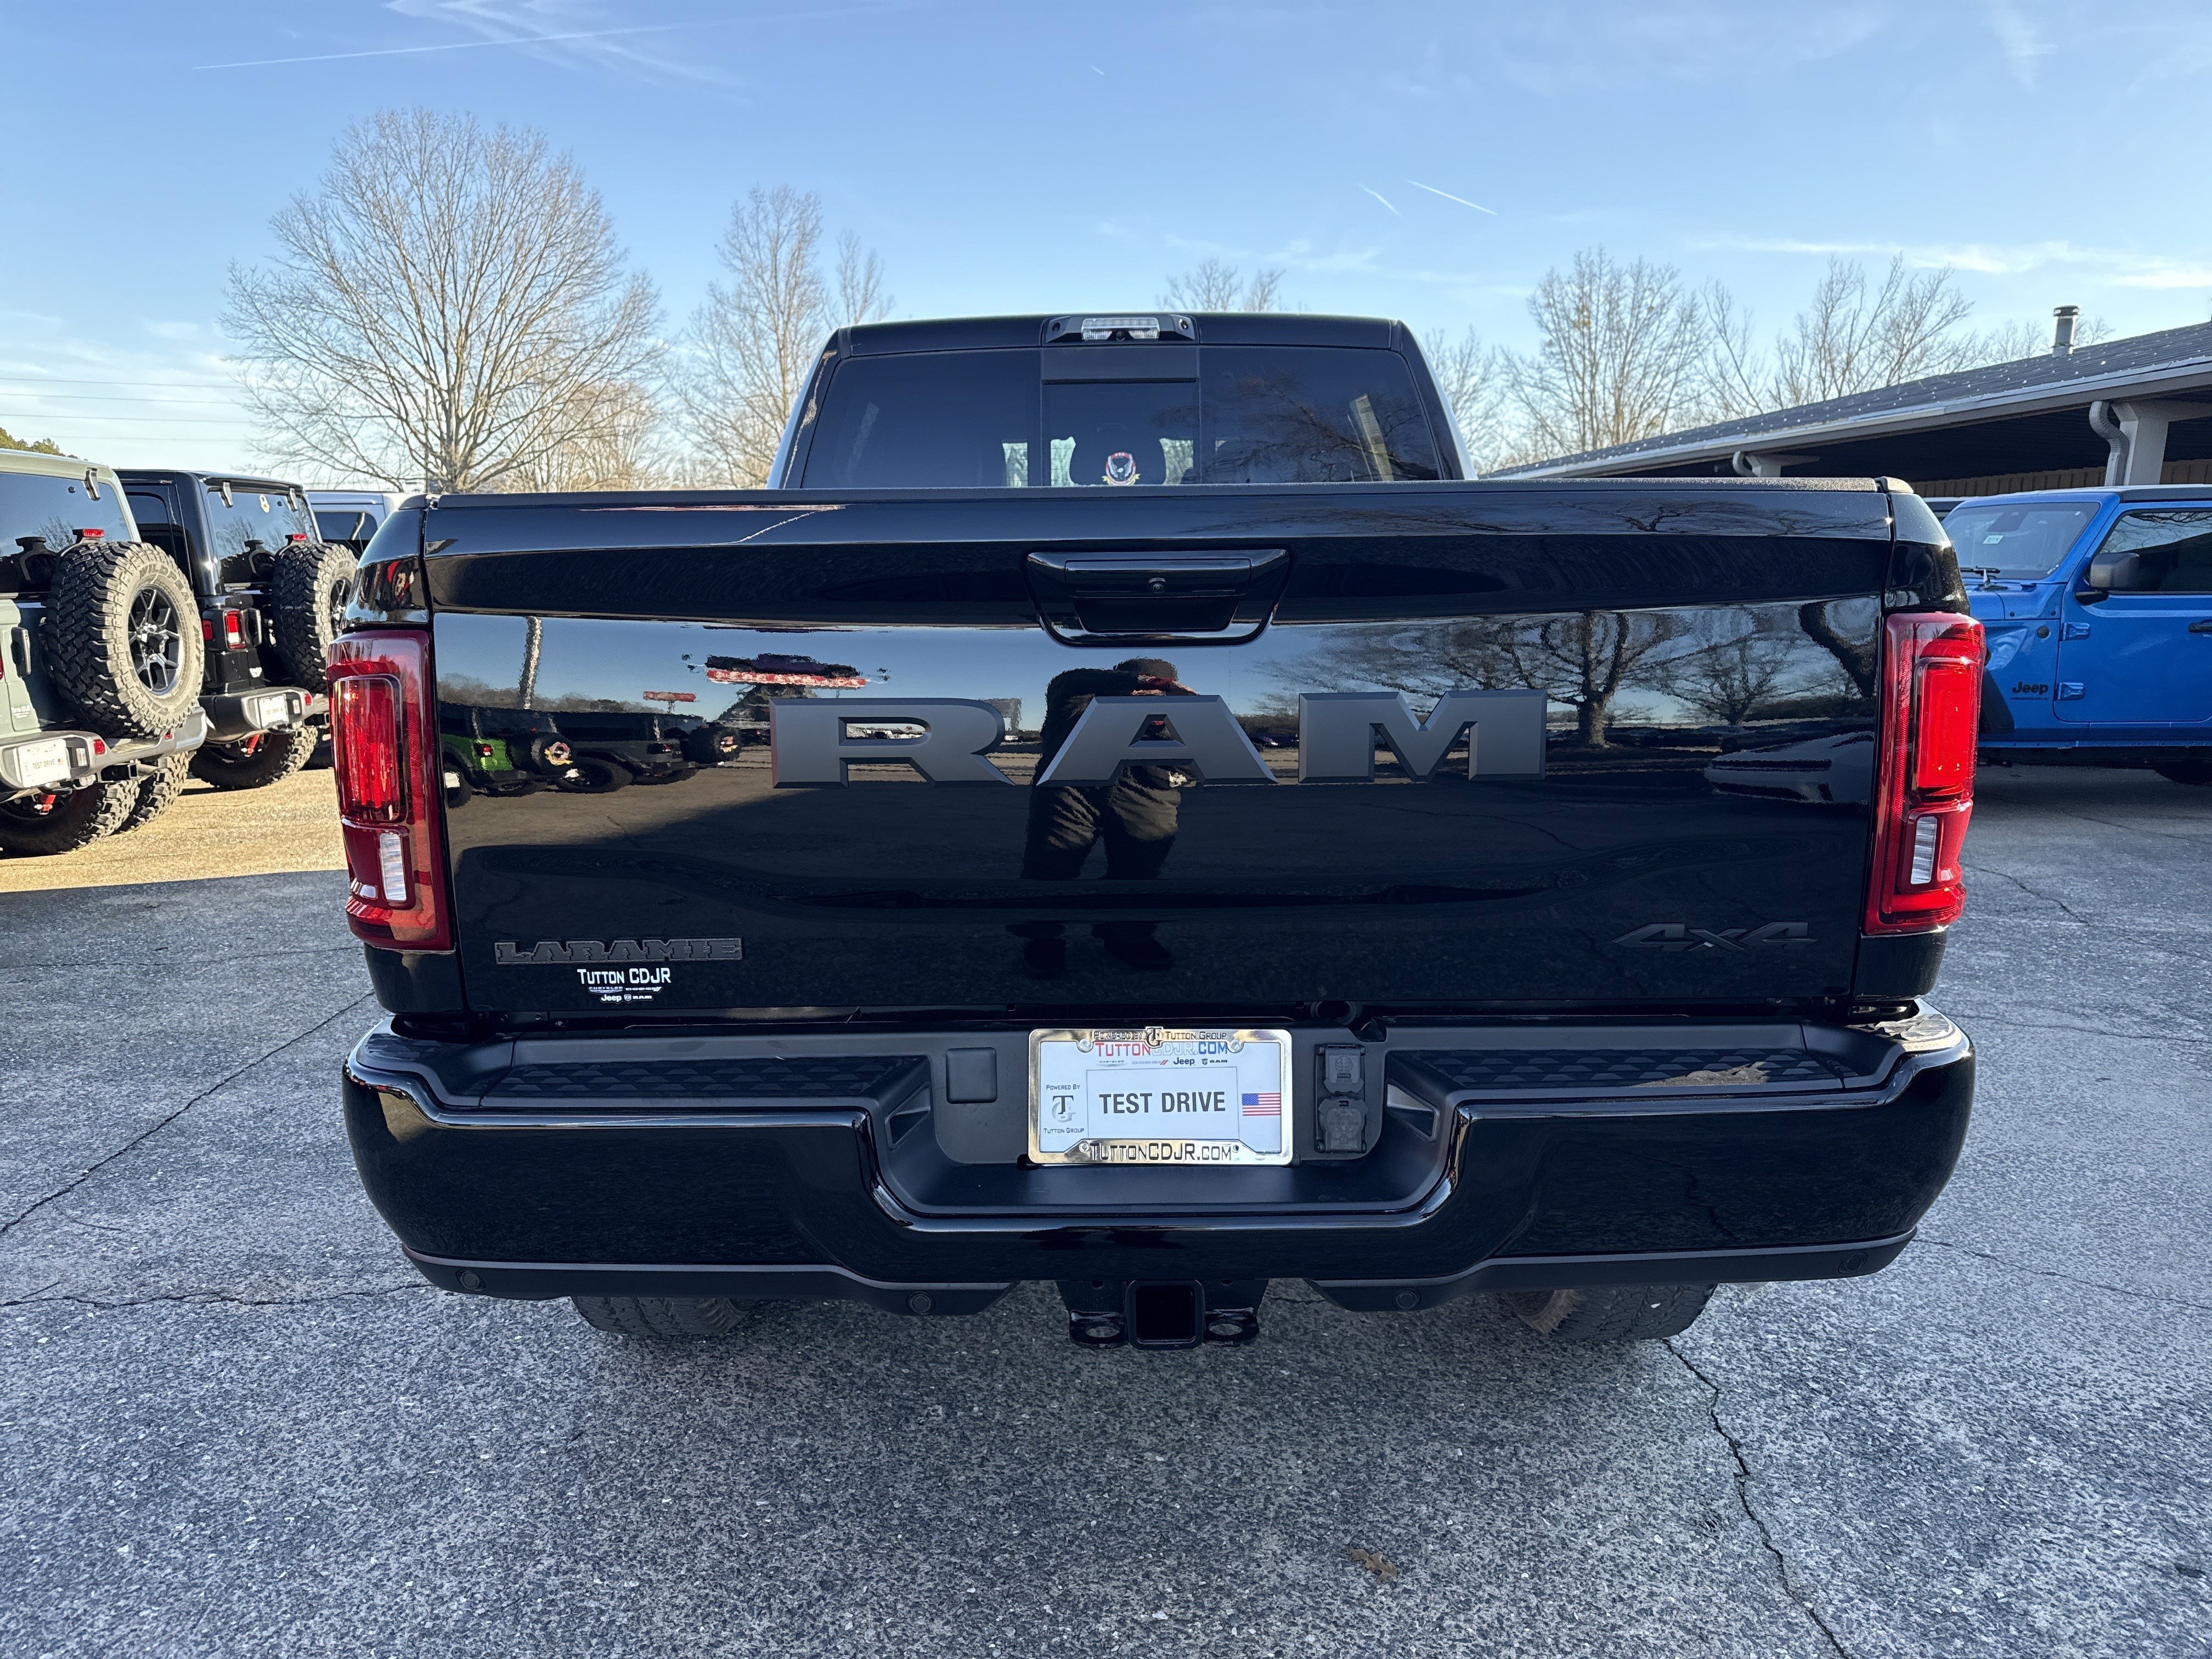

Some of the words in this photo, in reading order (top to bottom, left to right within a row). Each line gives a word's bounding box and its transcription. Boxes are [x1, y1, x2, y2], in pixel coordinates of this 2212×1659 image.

[2012, 681, 2049, 696] Jeep
[769, 689, 1548, 788] RAM
[494, 938, 742, 964] LARAMIE
[577, 968, 625, 984] TUTTON
[629, 967, 672, 984] CDJR
[601, 994, 622, 1002] Jeep
[1199, 1031, 1227, 1040] GROUP
[1173, 1057, 1195, 1066] Jeep
[1098, 1092, 1153, 1114] TEST
[1161, 1091, 1226, 1113] DRIVE
